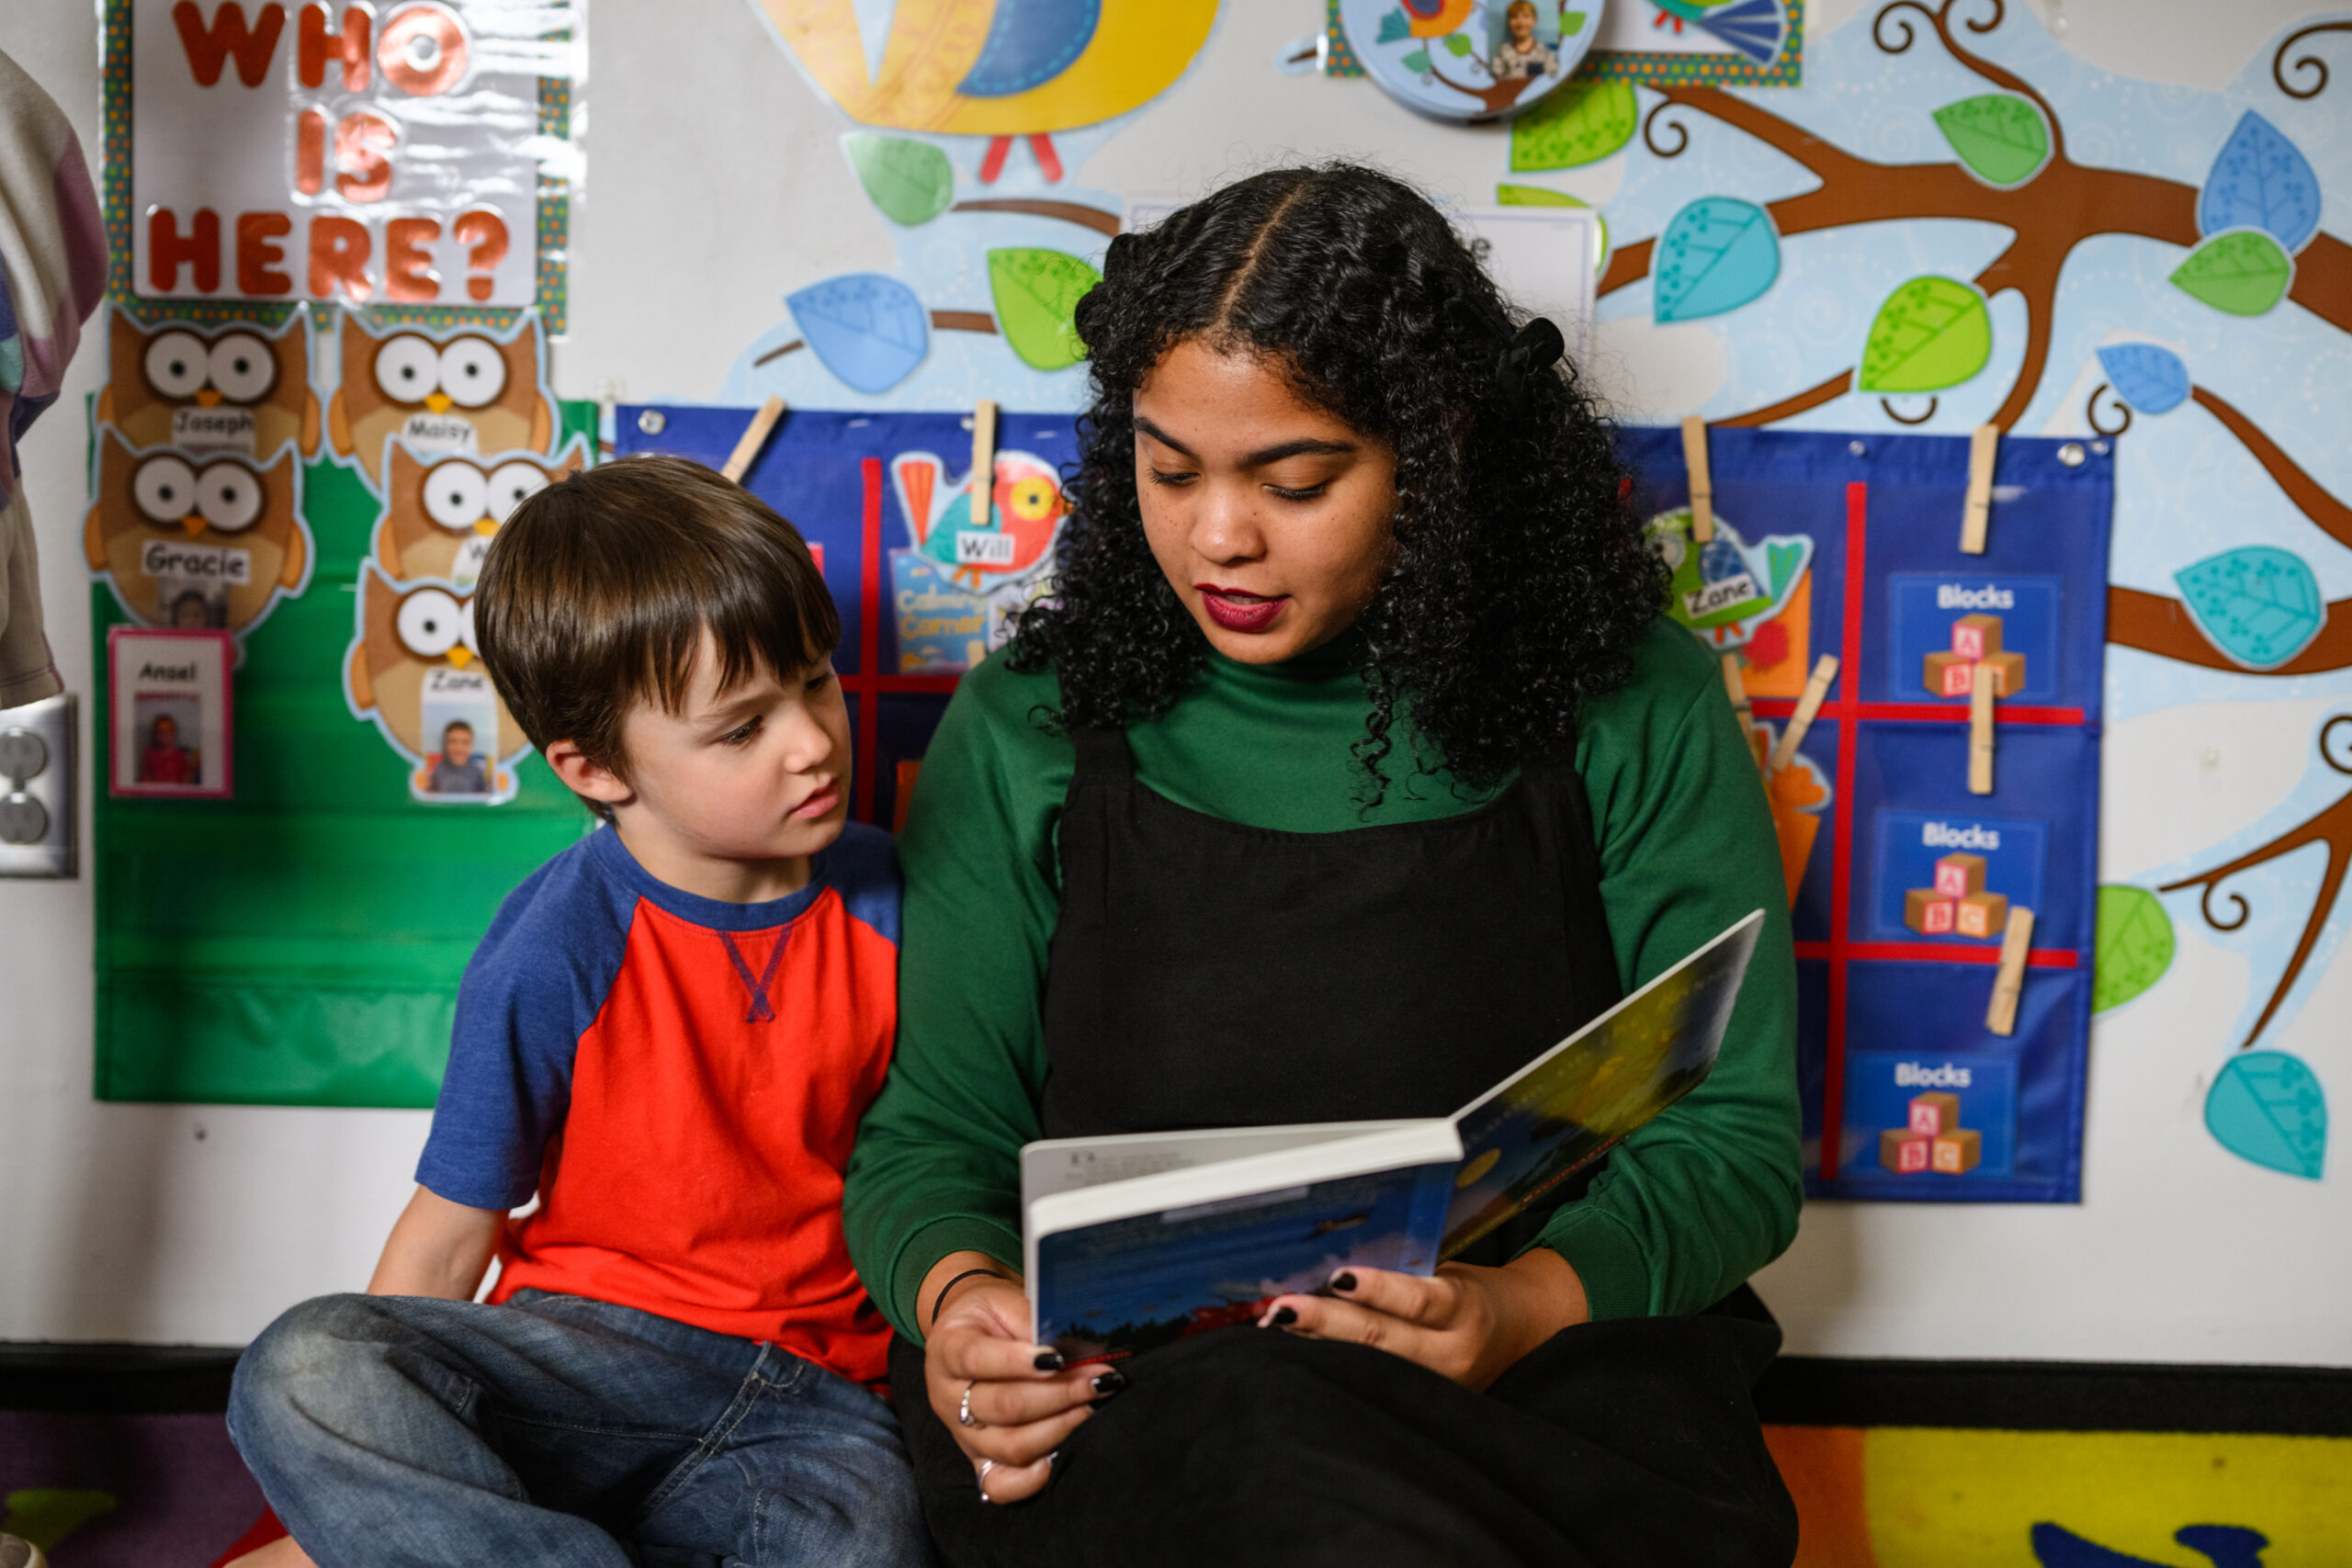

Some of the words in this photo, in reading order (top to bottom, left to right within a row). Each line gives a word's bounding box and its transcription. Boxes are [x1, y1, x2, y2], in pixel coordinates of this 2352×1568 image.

[172, 1, 470, 96] WHO
[297, 107, 397, 203] IS
[148, 207, 510, 302] HERE?
[174, 411, 254, 436] Joseph
[408, 418, 472, 442] Maisy
[961, 536, 1010, 558] Will
[145, 544, 245, 580] Gracie
[1687, 581, 1748, 614] Zane
[1937, 583, 2015, 610] Blocks
[138, 661, 198, 682] Ansel
[430, 670, 483, 693] Zane
[1922, 821, 2000, 851] Blocks
[1894, 1061, 1973, 1089] Blocks
